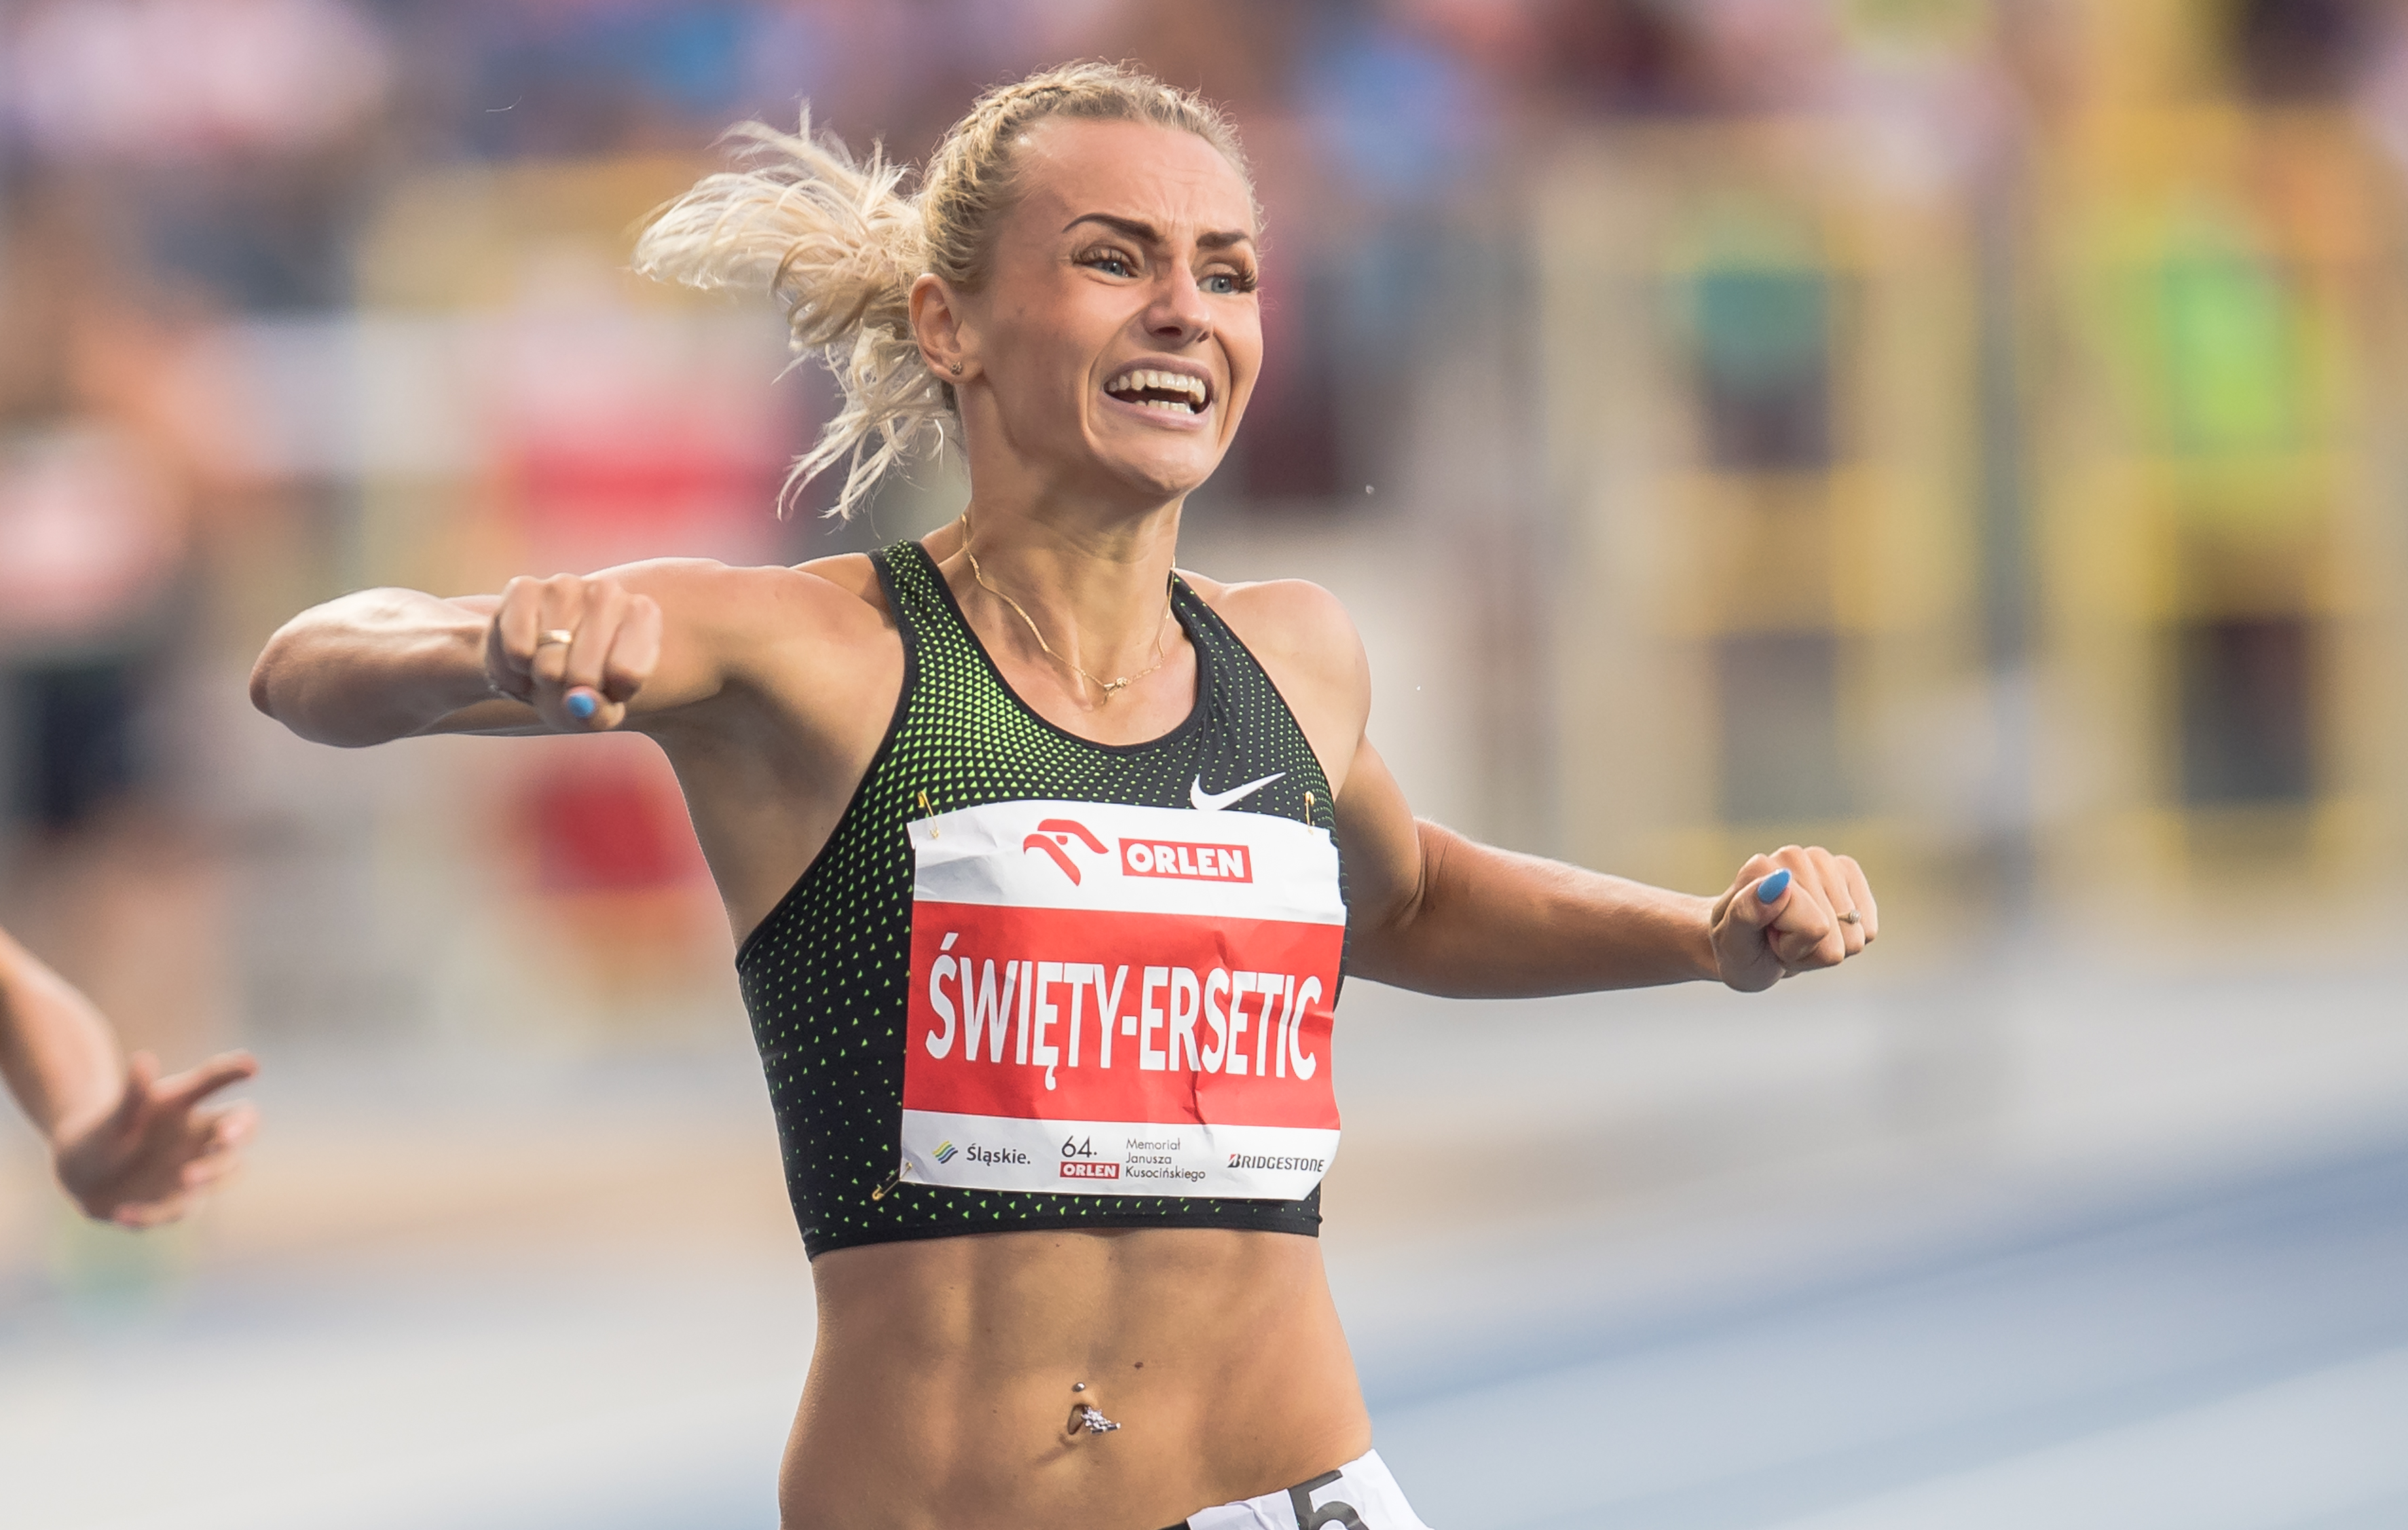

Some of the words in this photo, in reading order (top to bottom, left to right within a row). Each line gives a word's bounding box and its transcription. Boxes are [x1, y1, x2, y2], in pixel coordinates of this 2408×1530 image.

[1126, 843, 1244, 878] ORLEN
[925, 932, 1322, 1090] ŚWIĘTY-ERSETIC
[1061, 1136, 1097, 1158] 64.
[1126, 1138, 1181, 1150] Memoriał
[967, 1143, 1031, 1166] Śląskie.
[1126, 1152, 1172, 1164] Janusza
[1227, 1154, 1325, 1172] BRIDGESTONE
[1063, 1164, 1116, 1178] ORLEN
[1126, 1165, 1206, 1182] Kusocińskiego
